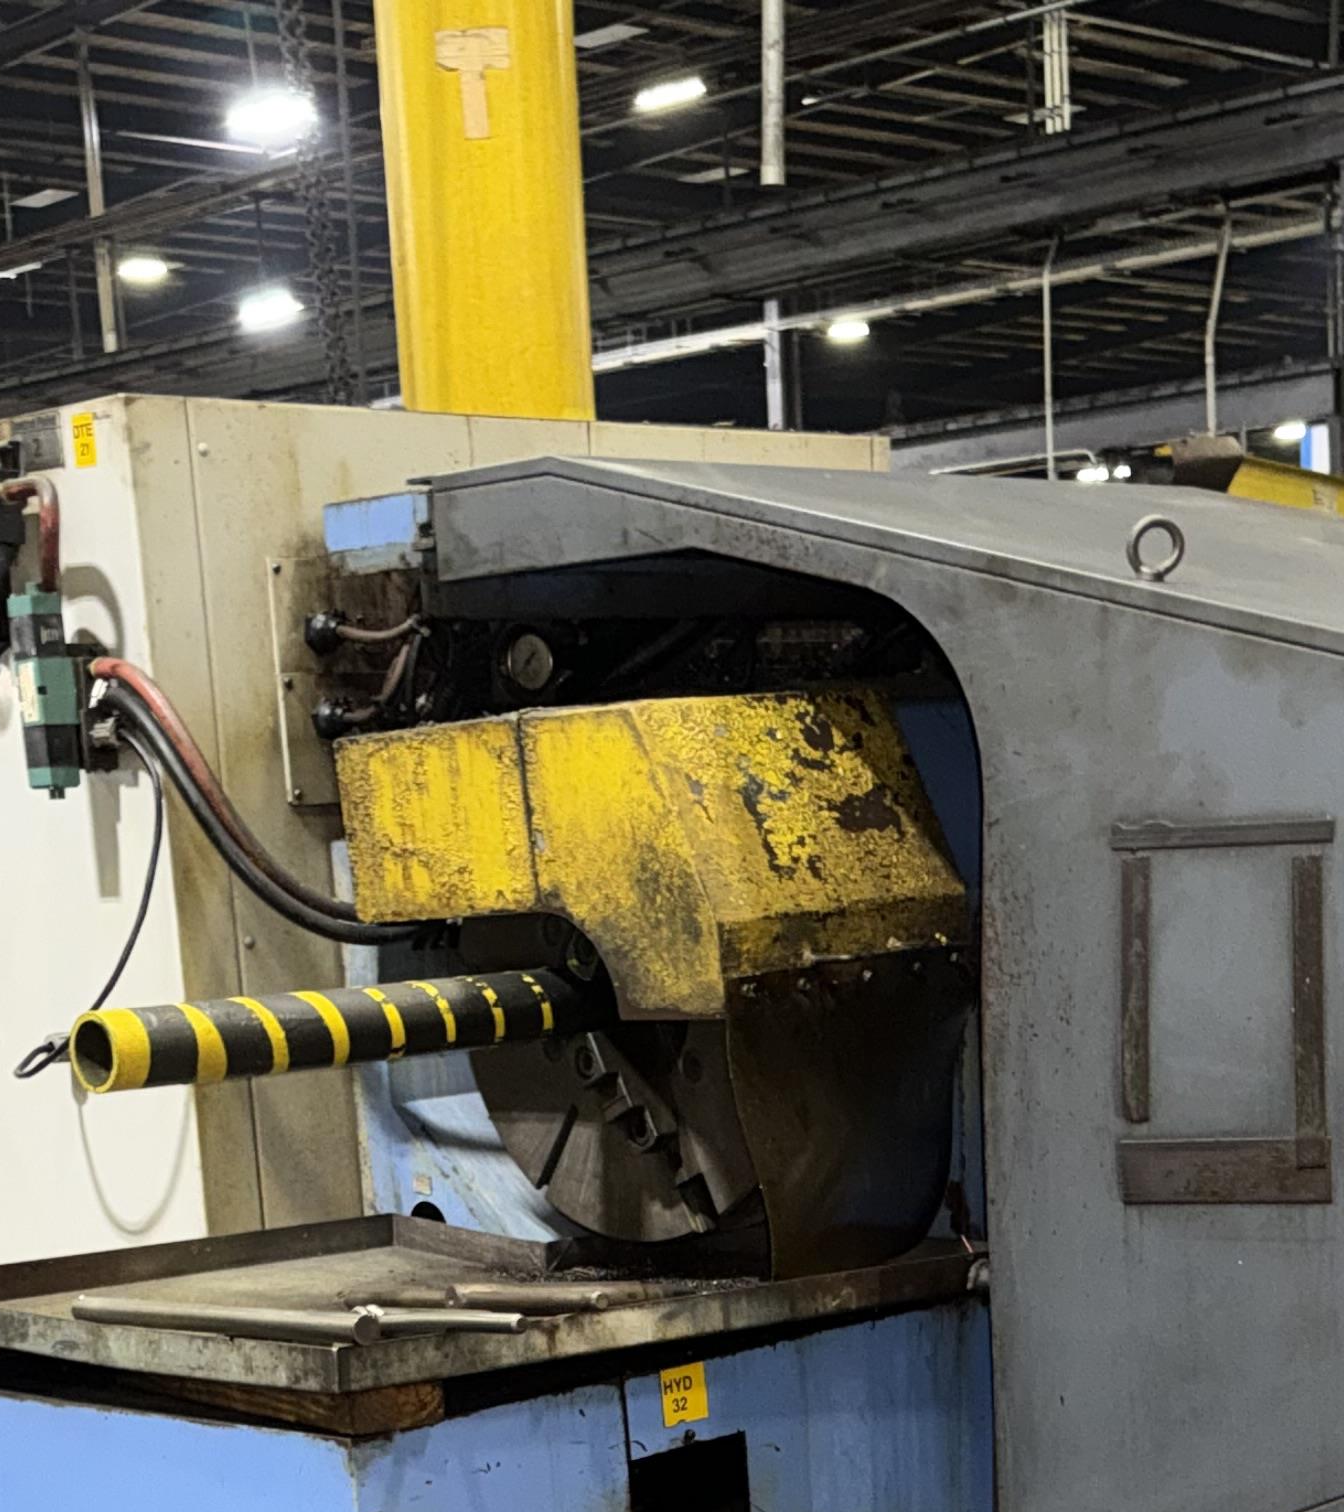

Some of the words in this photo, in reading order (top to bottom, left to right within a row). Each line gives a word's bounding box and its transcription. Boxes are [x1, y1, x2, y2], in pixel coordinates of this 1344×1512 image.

[72, 422, 93, 439] DTE
[663, 1375, 693, 1396] HYD
[672, 1396, 688, 1413] 32
